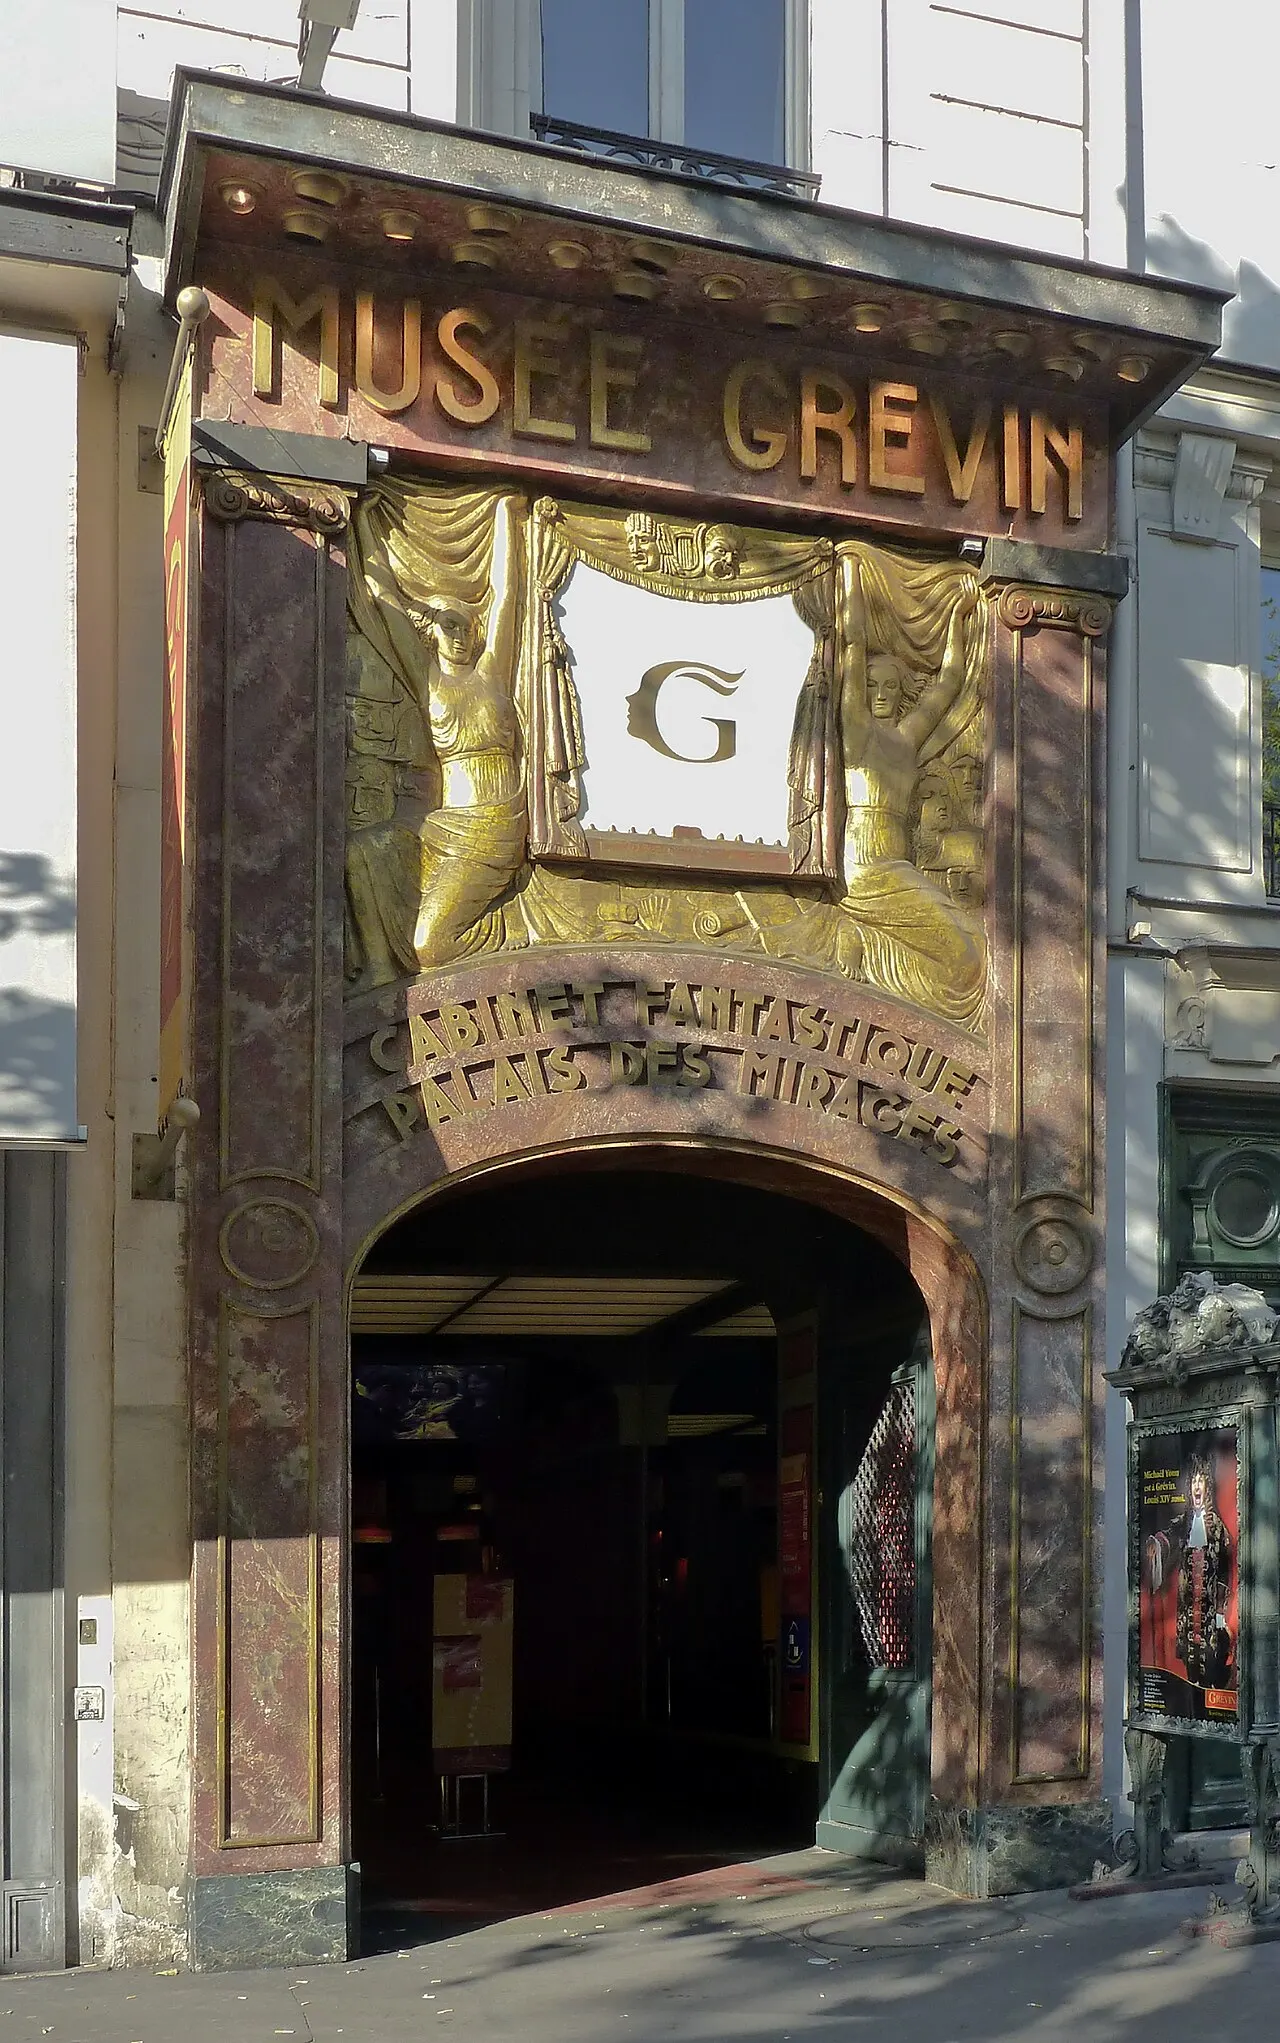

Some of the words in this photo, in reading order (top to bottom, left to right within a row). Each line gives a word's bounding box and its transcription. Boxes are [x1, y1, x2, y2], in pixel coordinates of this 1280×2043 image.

[723, 357, 1084, 520] GREVIN
[625, 660, 747, 764] G
[369, 983, 605, 1073] CABINET
[634, 982, 976, 1106] FANTASTIQUE
[382, 1045, 584, 1140] PALAIS
[610, 1041, 712, 1088] DES
[738, 1049, 967, 1166] MIRAGES
[1143, 1495, 1159, 1505] Louis
